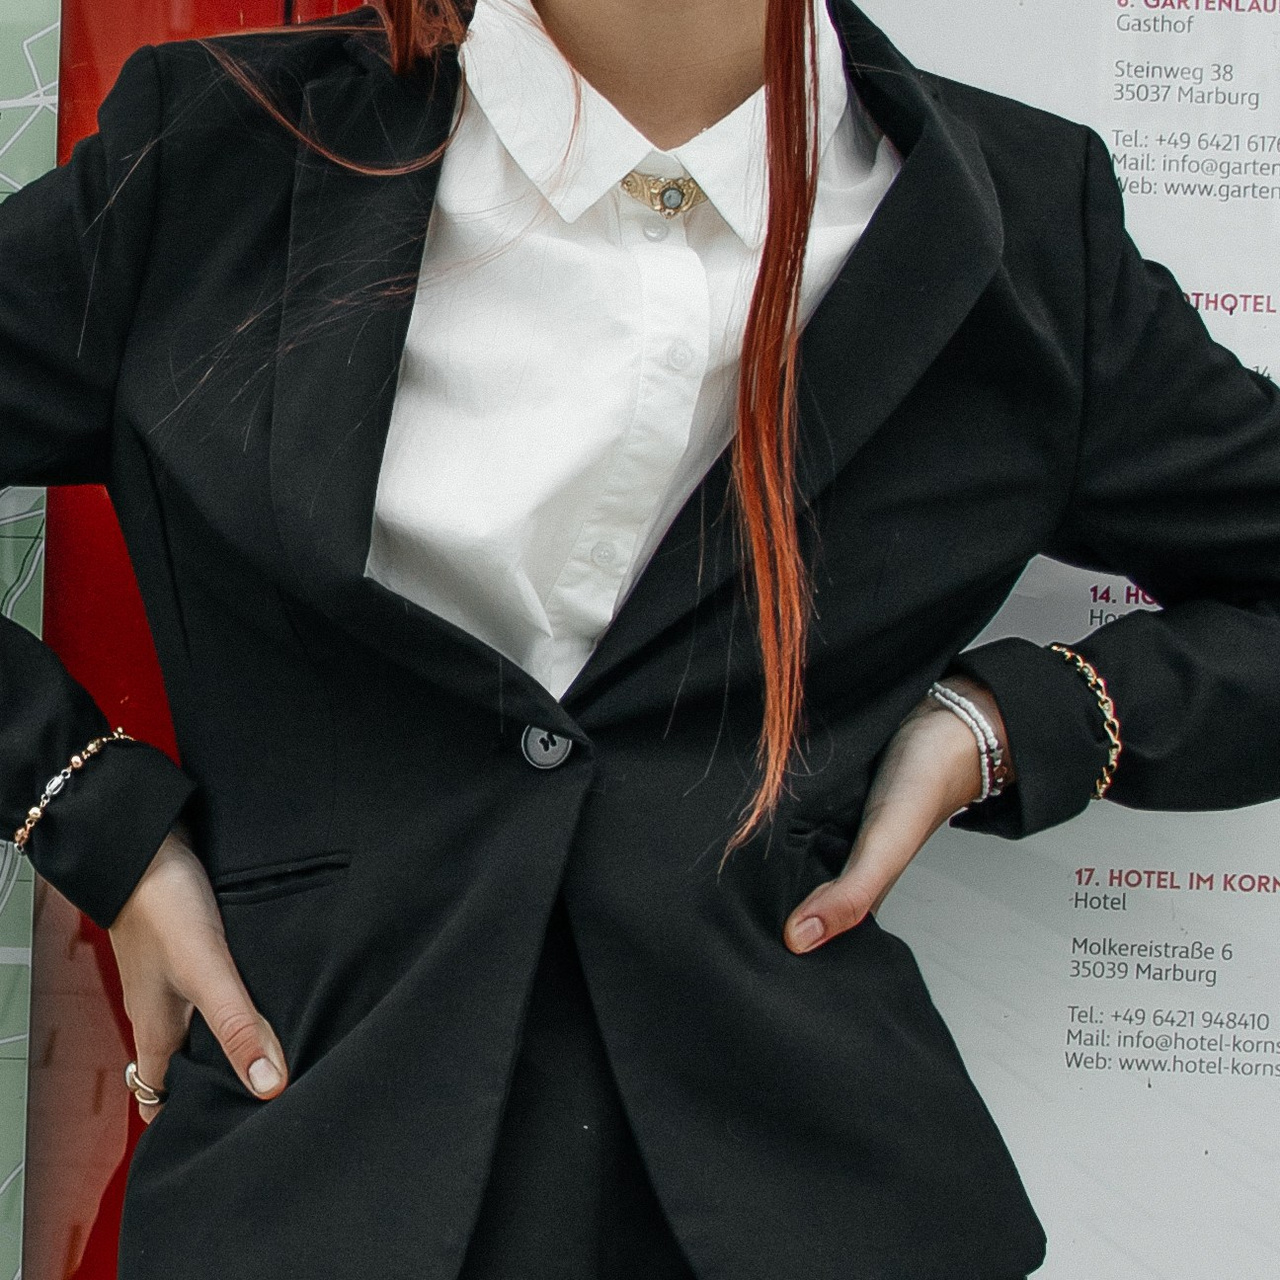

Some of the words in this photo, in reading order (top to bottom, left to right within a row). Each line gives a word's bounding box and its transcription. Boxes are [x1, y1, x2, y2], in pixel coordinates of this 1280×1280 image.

[1116, 14, 1194, 34] Gasthof
[1114, 60, 1204, 85] Steinweg
[1210, 63, 1234, 82] 38
[1113, 83, 1171, 102] 35037
[1177, 85, 1260, 111] Marburg
[1111, 129, 1149, 148] Tel.:
[1155, 132, 1191, 150] +49
[1197, 133, 1240, 151] 6421
[1112, 153, 1155, 172] Mail:
[1162, 155, 1280, 179] info@garten
[1164, 181, 1280, 202] www.garten
[1090, 585, 1117, 604] 14.
[1075, 868, 1100, 886] 17.
[1108, 869, 1181, 890] HOTEL
[1188, 872, 1215, 891] IM
[1074, 892, 1127, 911] Hotel
[1072, 937, 1215, 961] Molkereistraße
[1221, 943, 1233, 961] 6
[1069, 959, 1129, 979] 35039
[1135, 963, 1217, 987] Marburg
[1068, 1005, 1104, 1024] Tel.:
[1110, 1008, 1146, 1026] +49
[1153, 1009, 1195, 1028] 6421
[1201, 1010, 1270, 1031] 948410
[1066, 1029, 1110, 1047] Mail:
[1065, 1051, 1112, 1070] Web:
